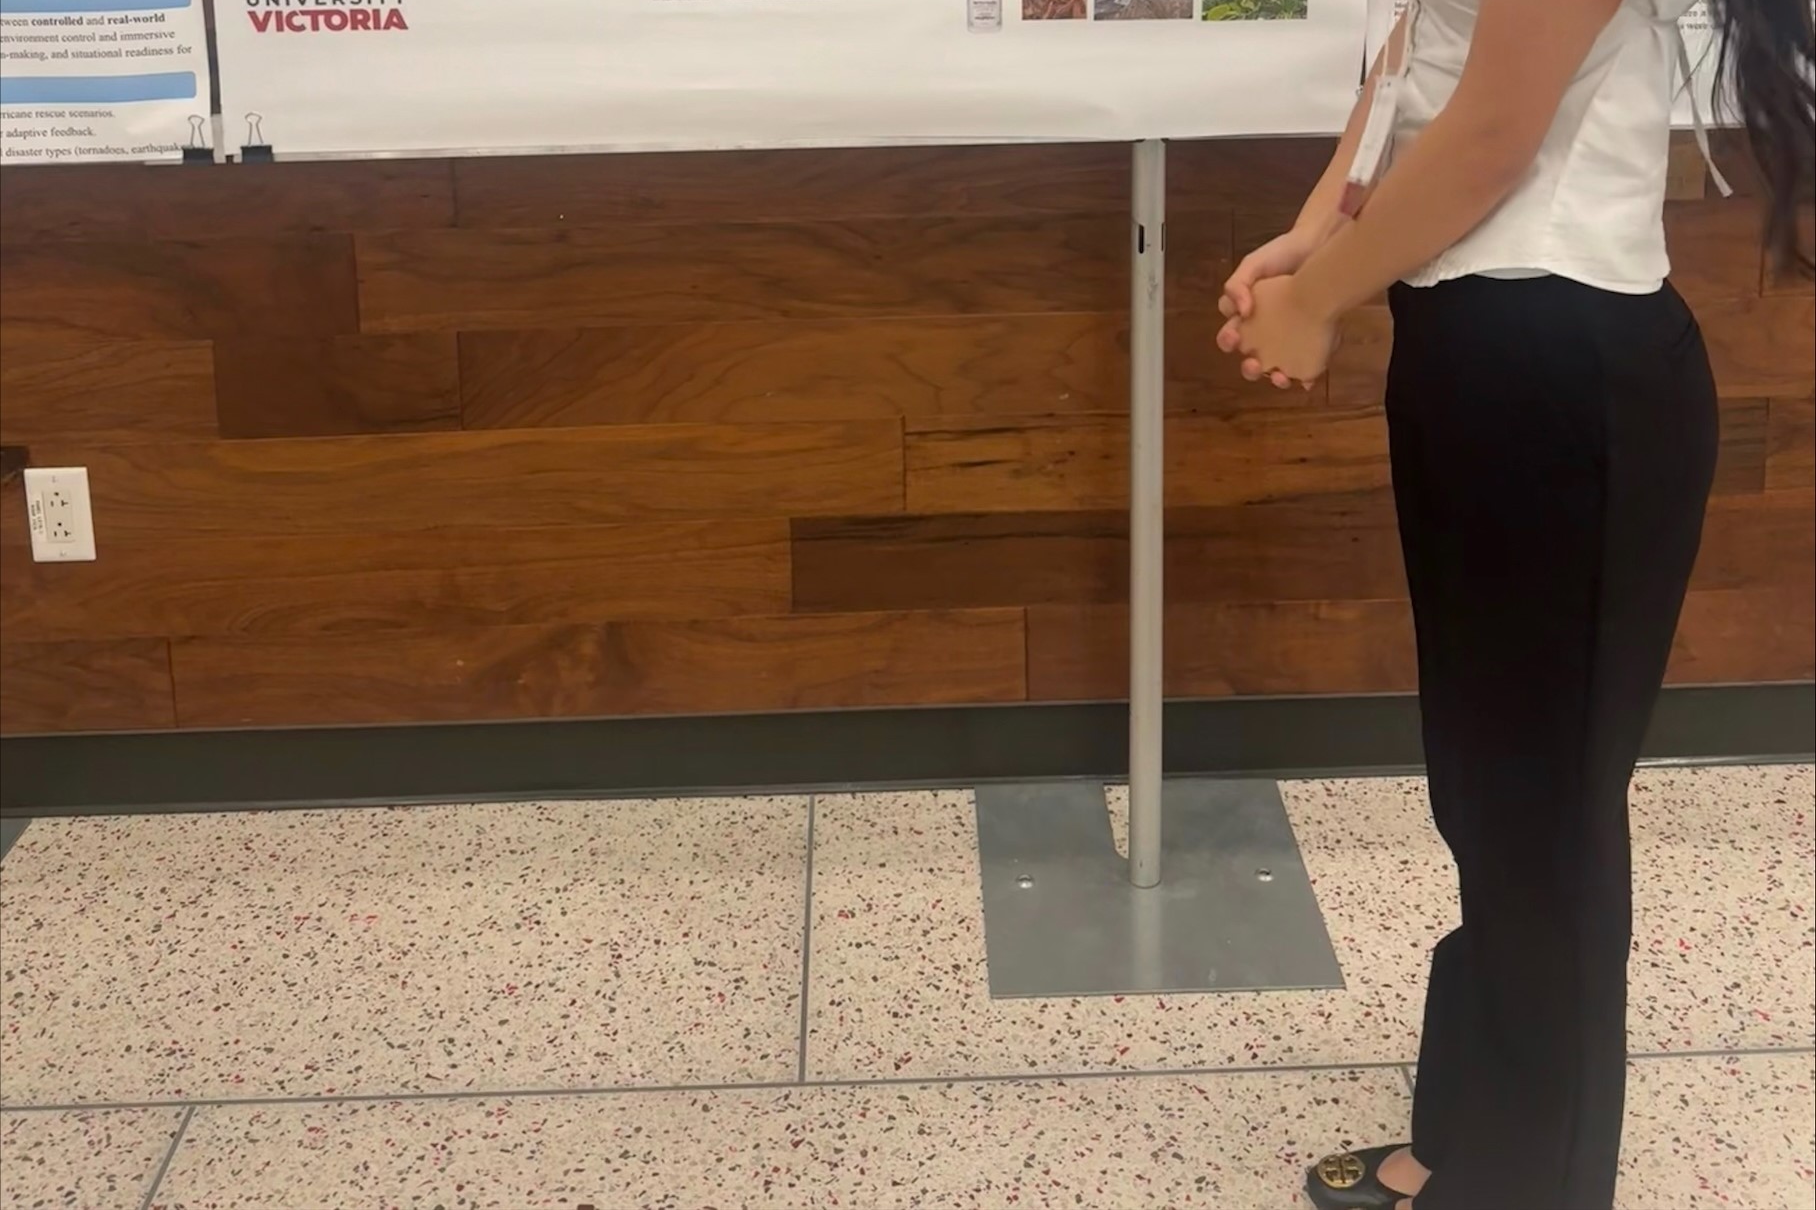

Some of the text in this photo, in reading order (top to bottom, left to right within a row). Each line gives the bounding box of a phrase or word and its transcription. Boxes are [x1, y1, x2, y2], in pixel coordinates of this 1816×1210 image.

[31, 12, 165, 26] controlled and real-world
[247, 8, 408, 32] VICTORIA
[61, 32, 96, 42] control
[98, 31, 117, 42] and
[120, 30, 175, 40] immersive
[51, 44, 192, 59] and situational readiness for
[68, 110, 114, 118] scenarios.
[6, 126, 96, 140] adaptive feedback.
[5, 146, 42, 157] disaster
[45, 147, 72, 158] types
[74, 144, 128, 156] (tornadoes,
